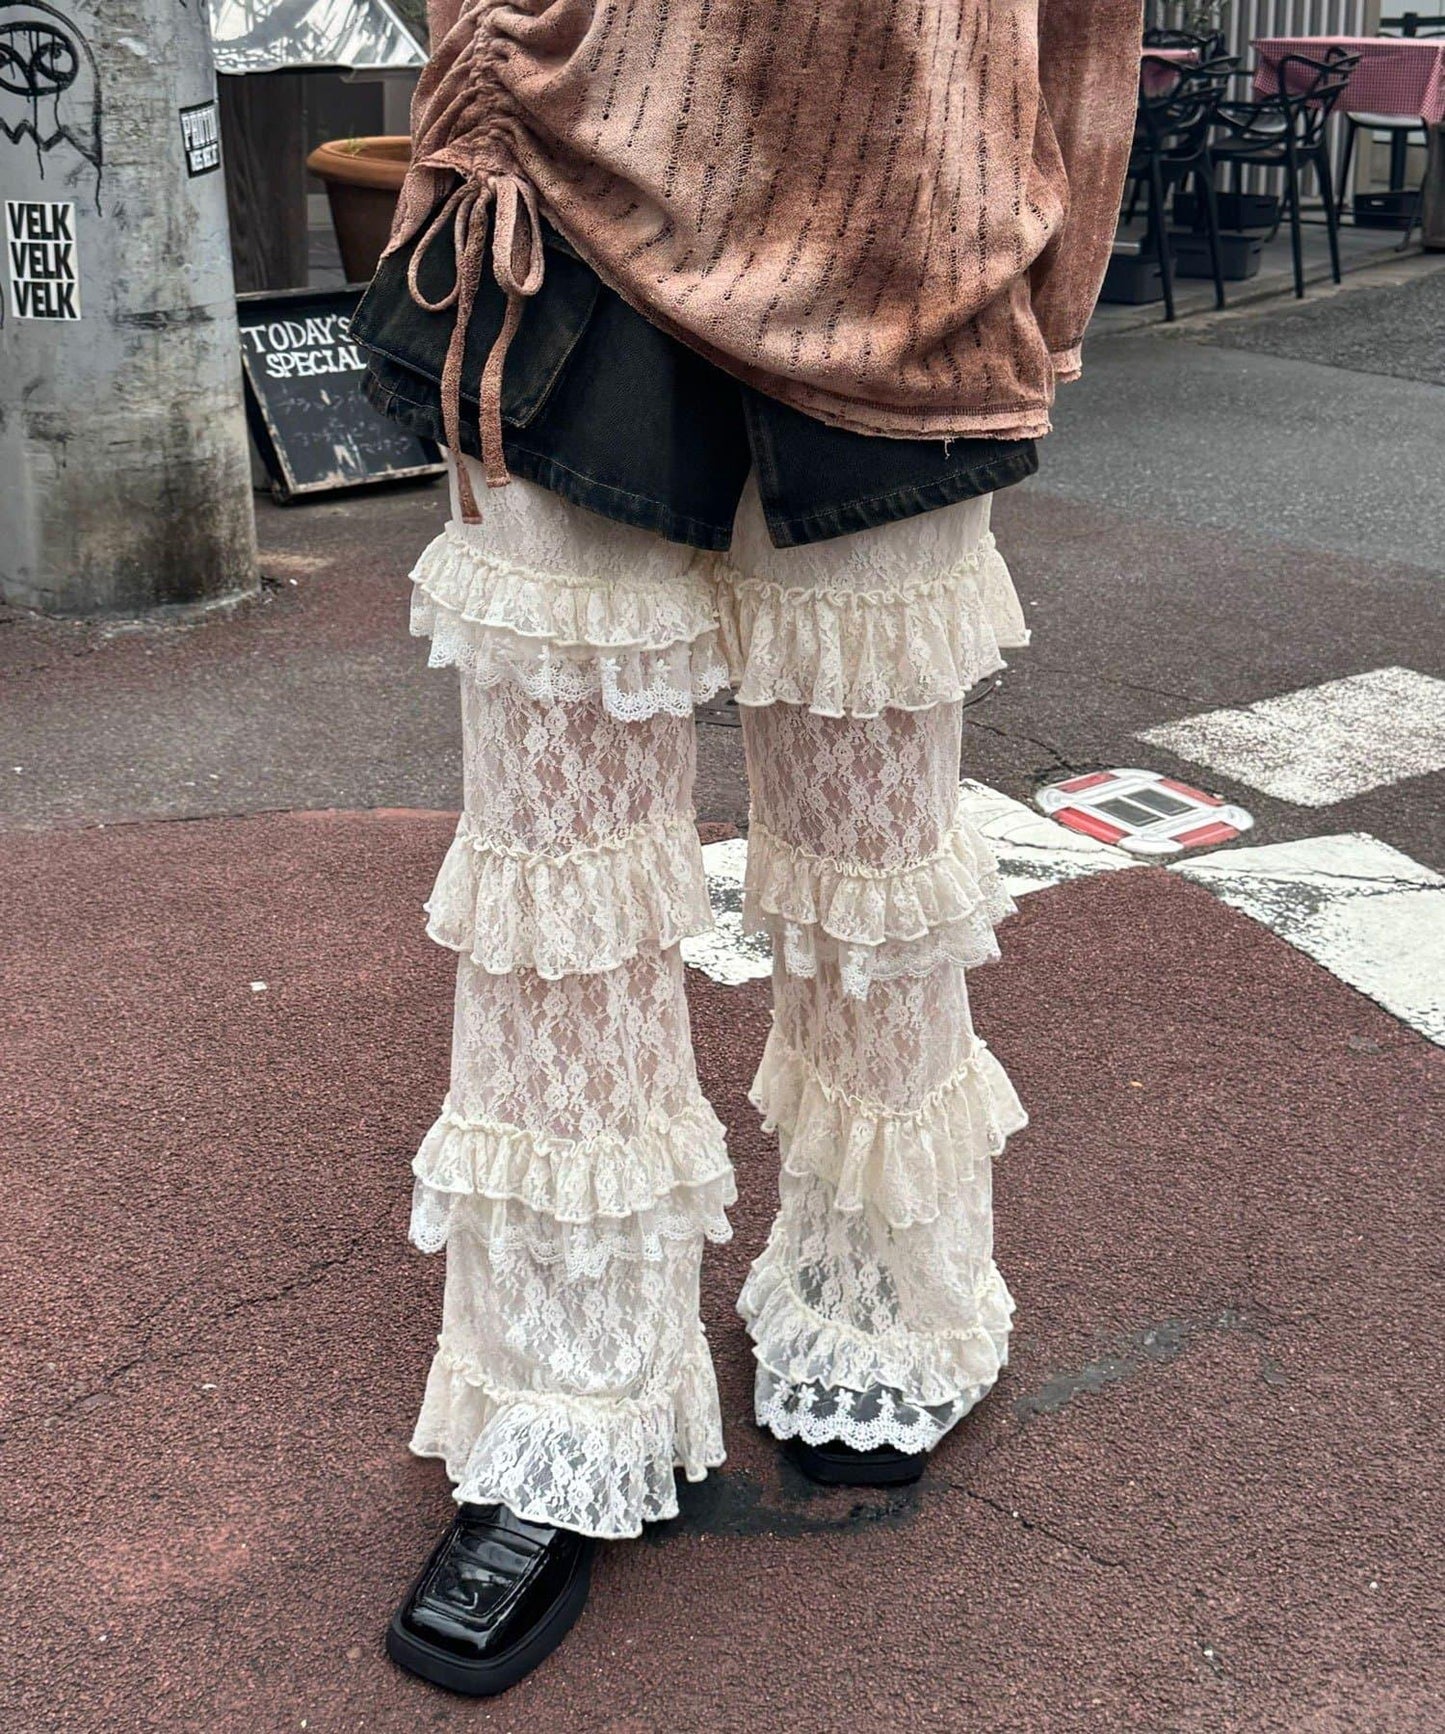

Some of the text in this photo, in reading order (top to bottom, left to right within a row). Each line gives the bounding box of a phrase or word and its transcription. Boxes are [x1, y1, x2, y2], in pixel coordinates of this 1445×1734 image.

[7, 202, 73, 241] VELK
[10, 241, 75, 280] VELK
[13, 280, 78, 319] VELK
[240, 313, 354, 354] TODAY'S
[265, 345, 368, 379] SPECIAL
